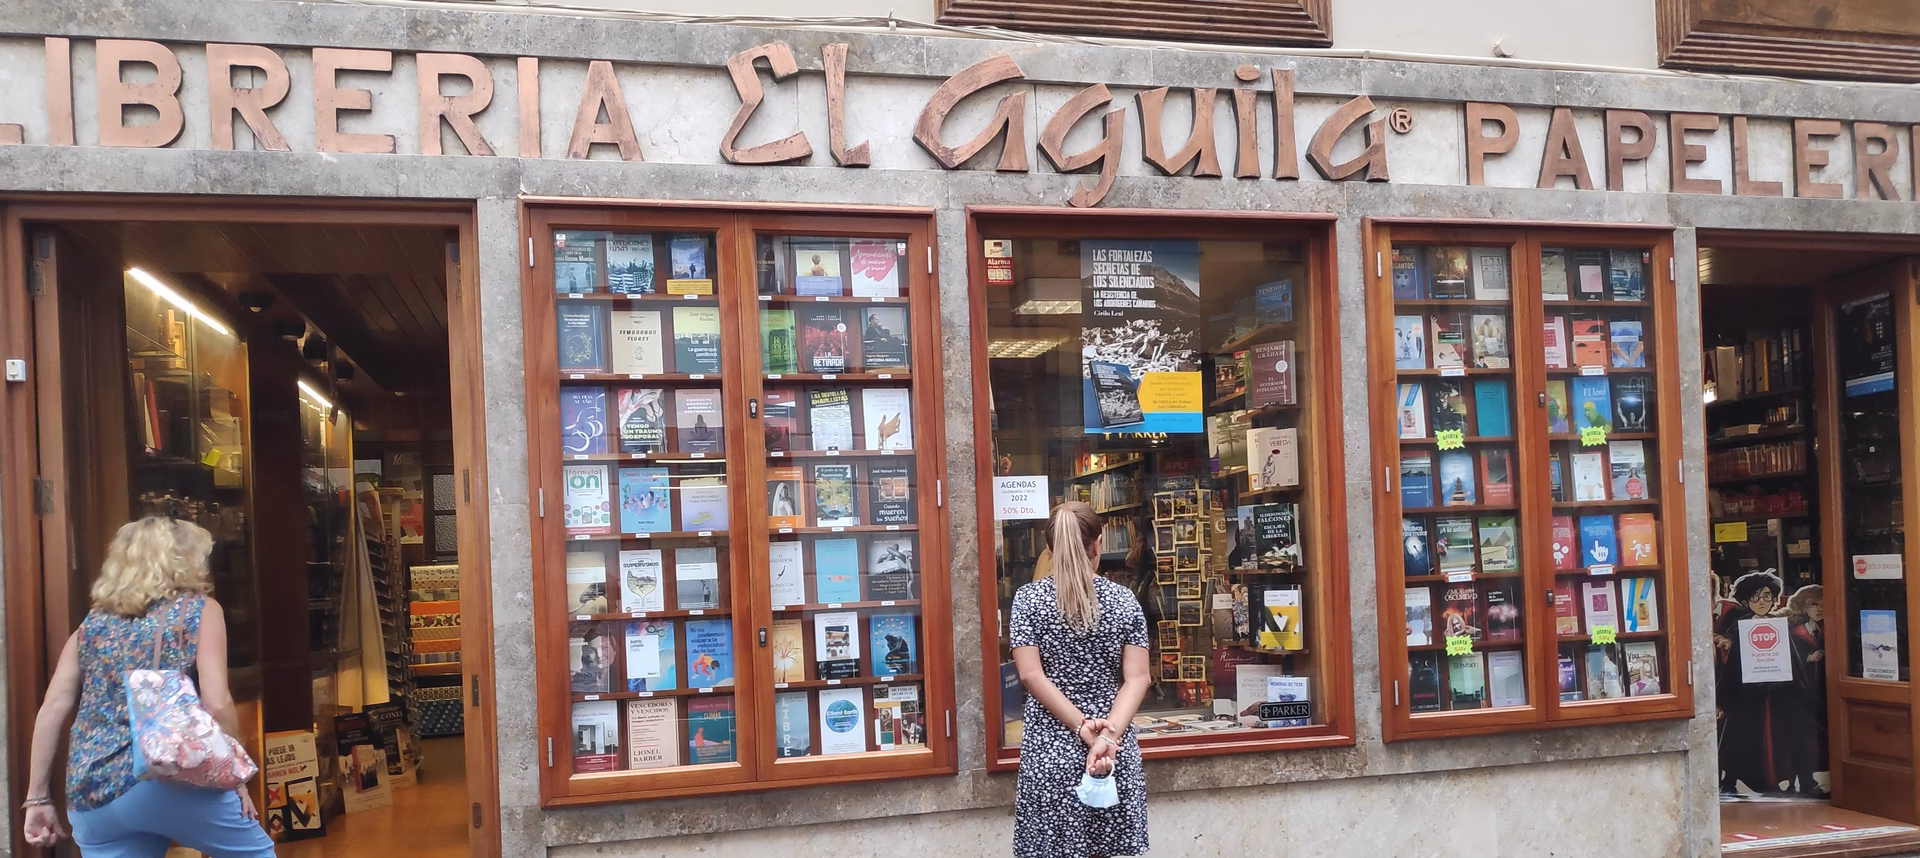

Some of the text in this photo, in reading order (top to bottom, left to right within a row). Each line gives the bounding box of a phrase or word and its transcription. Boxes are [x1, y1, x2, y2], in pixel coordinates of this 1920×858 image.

[0, 37, 643, 162] IBRERIA
[719, 42, 870, 167] El
[1092, 249, 1152, 262] LAS FORTALEZAS
[1093, 263, 1140, 275] SECRETAS DE
[1093, 276, 1154, 288] LOS SILENCIADOS
[1258, 283, 1287, 295] TENERIFE
[1093, 290, 1099, 298] LA
[1255, 344, 1285, 353] BENJAMIN
[1257, 350, 1284, 359] GRAHAM
[813, 358, 843, 367] RETIRADA
[1256, 385, 1288, 393] INTELIGENTE
[1583, 387, 1606, 396] El loro
[1257, 515, 1291, 523] FALCONES
[1444, 592, 1477, 601] OSCURIDAD
[1752, 632, 1775, 641] STOP
[630, 701, 673, 709] VENCEDORES
[1272, 705, 1308, 716] PARKER
[781, 697, 791, 756] LIBRE
[276, 753, 296, 764] LEJOS
